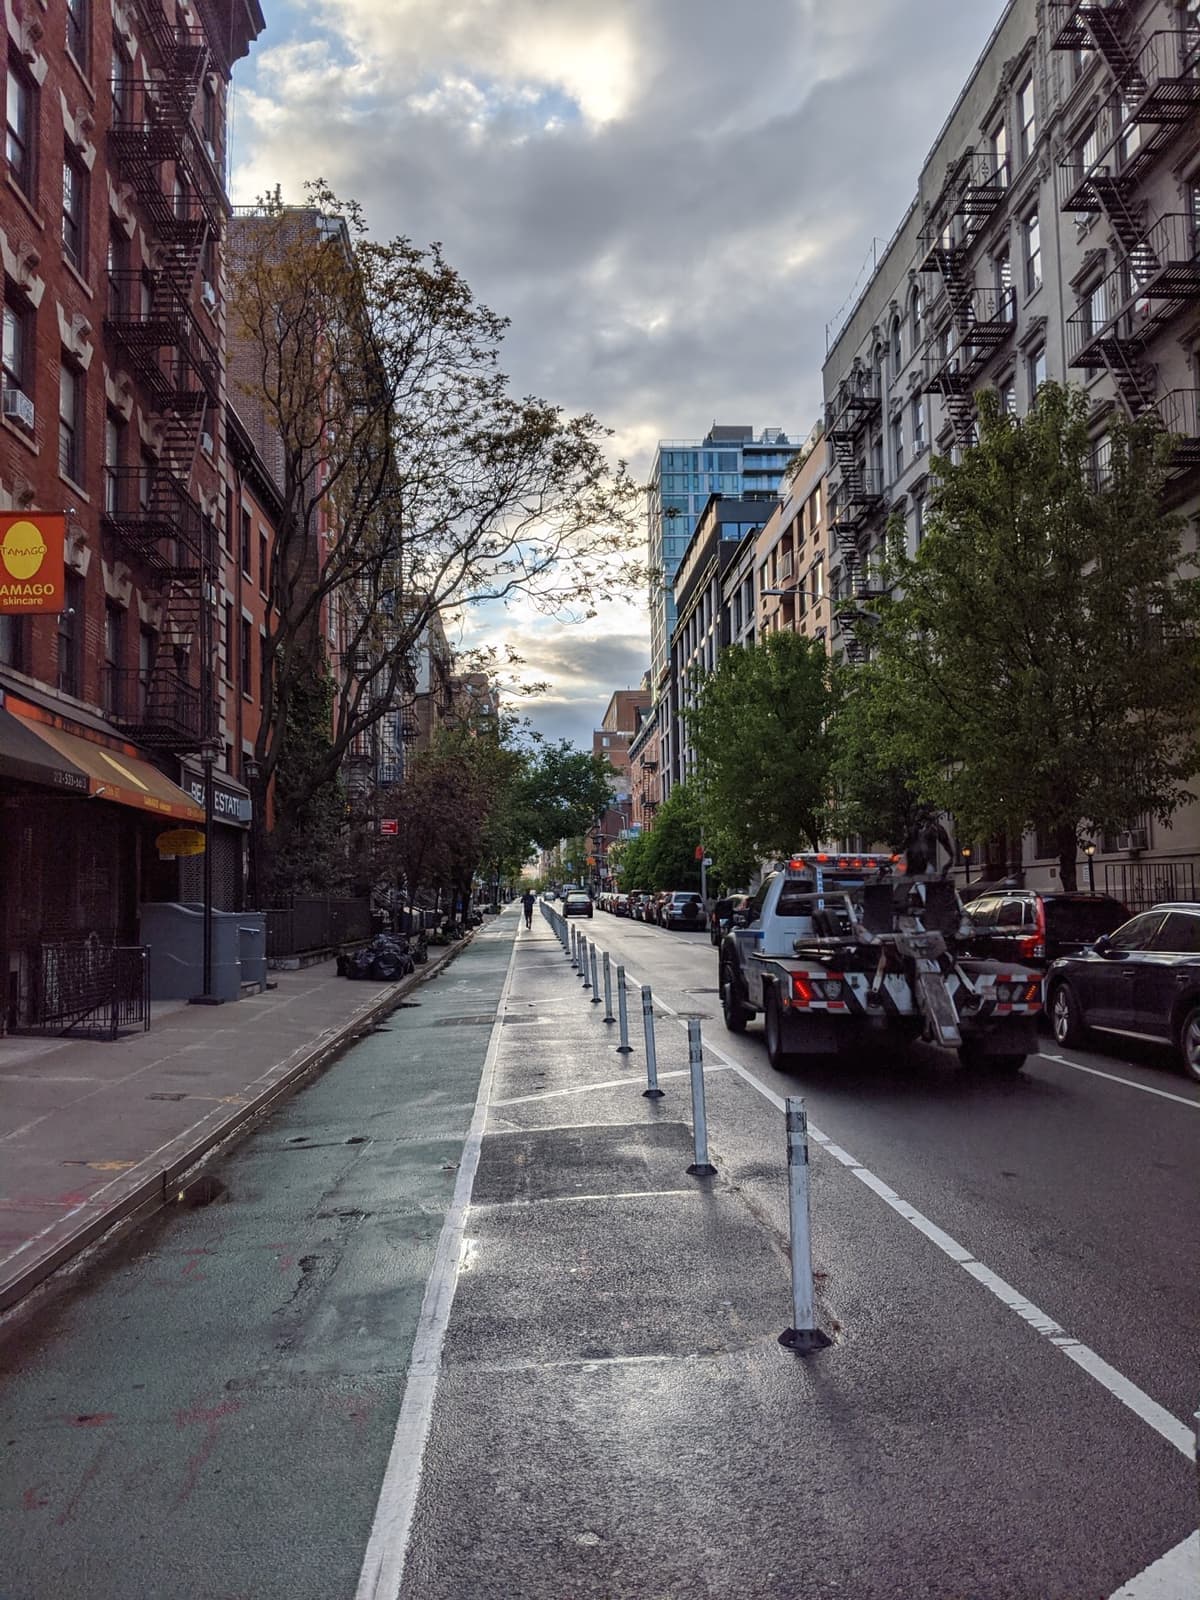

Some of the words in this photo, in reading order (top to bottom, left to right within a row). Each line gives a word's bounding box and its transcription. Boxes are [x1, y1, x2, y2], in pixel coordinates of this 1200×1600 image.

[1, 545, 46, 557] TAMAGO
[0, 583, 54, 596] AMAGO
[3, 596, 43, 606] skincare
